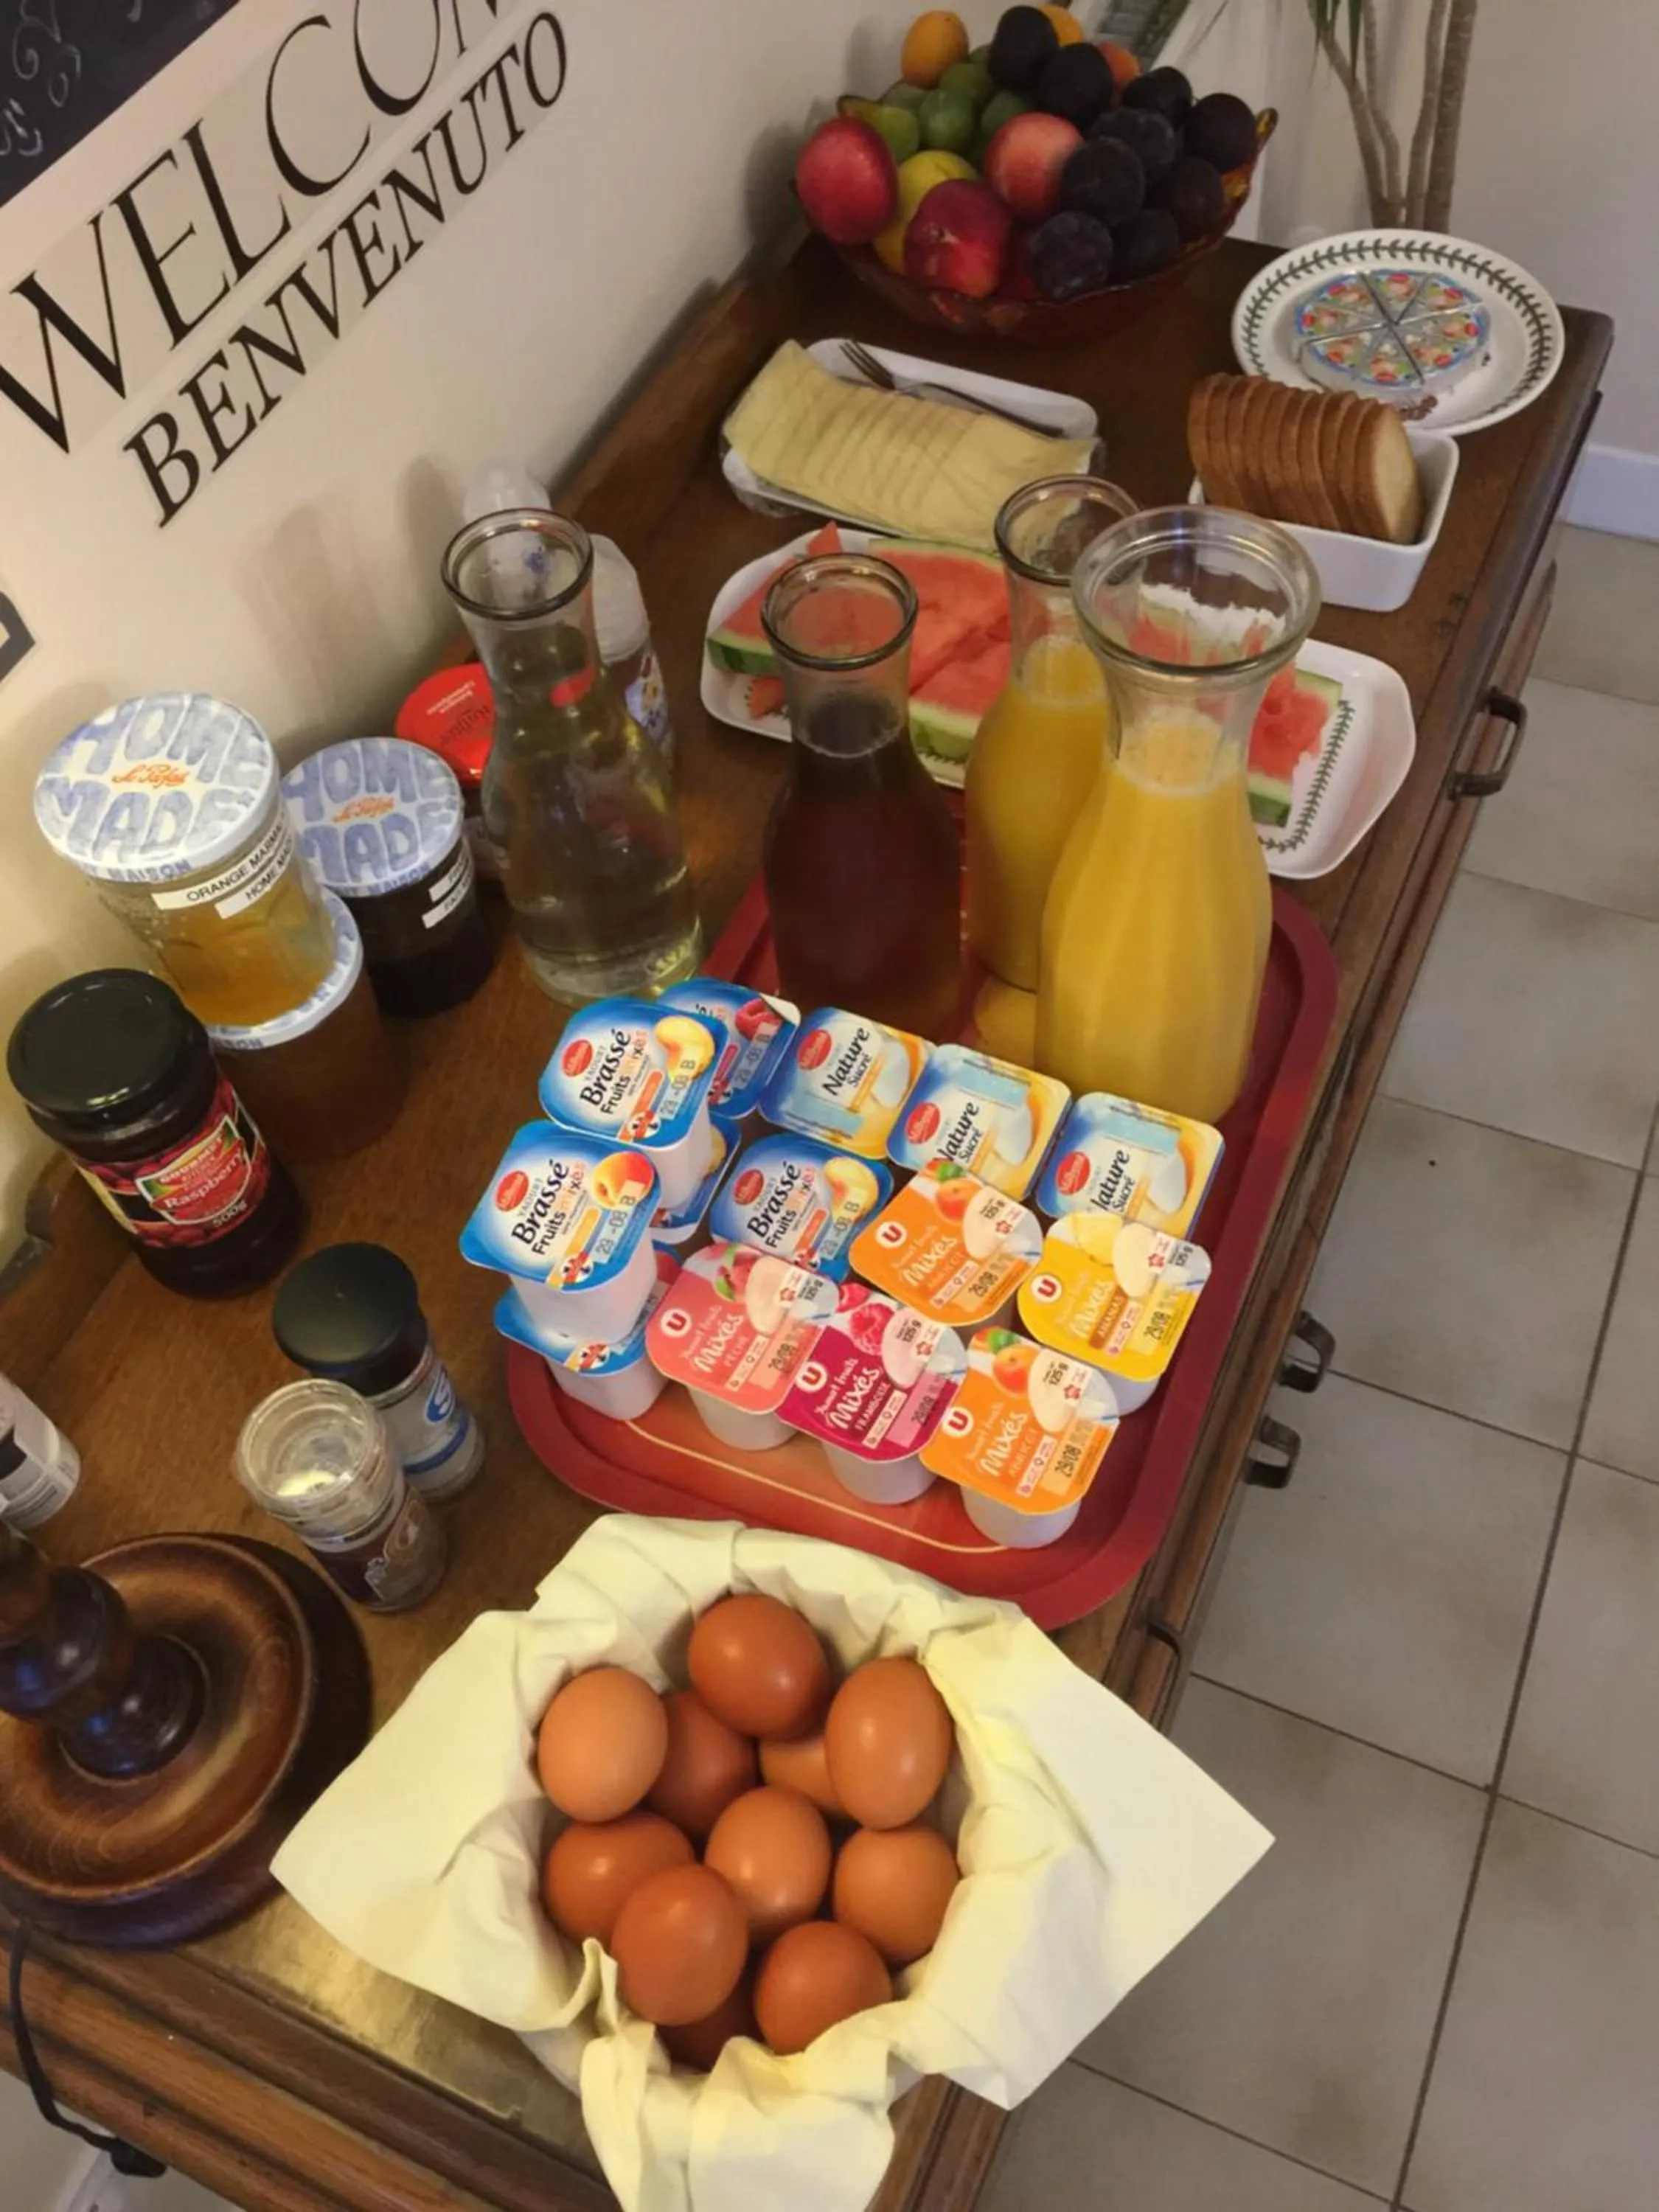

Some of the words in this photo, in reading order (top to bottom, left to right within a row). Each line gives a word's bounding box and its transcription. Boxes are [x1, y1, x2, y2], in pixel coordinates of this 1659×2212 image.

[122, 11, 567, 529] BENVENUTO
[44, 693, 271, 787] HOME
[282, 740, 461, 822] HOME
[35, 774, 256, 863] MADE
[187, 863, 249, 902] ORANGE
[246, 867, 279, 900] HOME
[580, 1028, 631, 1106] Brassé
[821, 1027, 871, 1096] Nature
[848, 1052, 873, 1088] Sucré
[599, 1076, 631, 1115] Fruits
[959, 1127, 984, 1163] Sucré
[163, 1147, 244, 1208] Raspberry
[747, 1161, 801, 1238] Brassé
[1112, 1175, 1135, 1213] Sucré
[511, 1159, 569, 1245] Brassé
[532, 1211, 566, 1255] Fruits
[765, 1210, 796, 1248] Fruits
[882, 1224, 902, 1243] U
[902, 1235, 957, 1287] Mixés
[1037, 1278, 1057, 1297] U
[666, 1312, 686, 1332] U
[1097, 1295, 1124, 1339] ANANAS
[694, 1312, 744, 1373] Mixés
[801, 1364, 822, 1385] U
[830, 1367, 880, 1430] Mixés
[947, 1411, 969, 1432] U
[979, 1412, 1029, 1477] Mixés
[1054, 1444, 1082, 1478] 29/08
